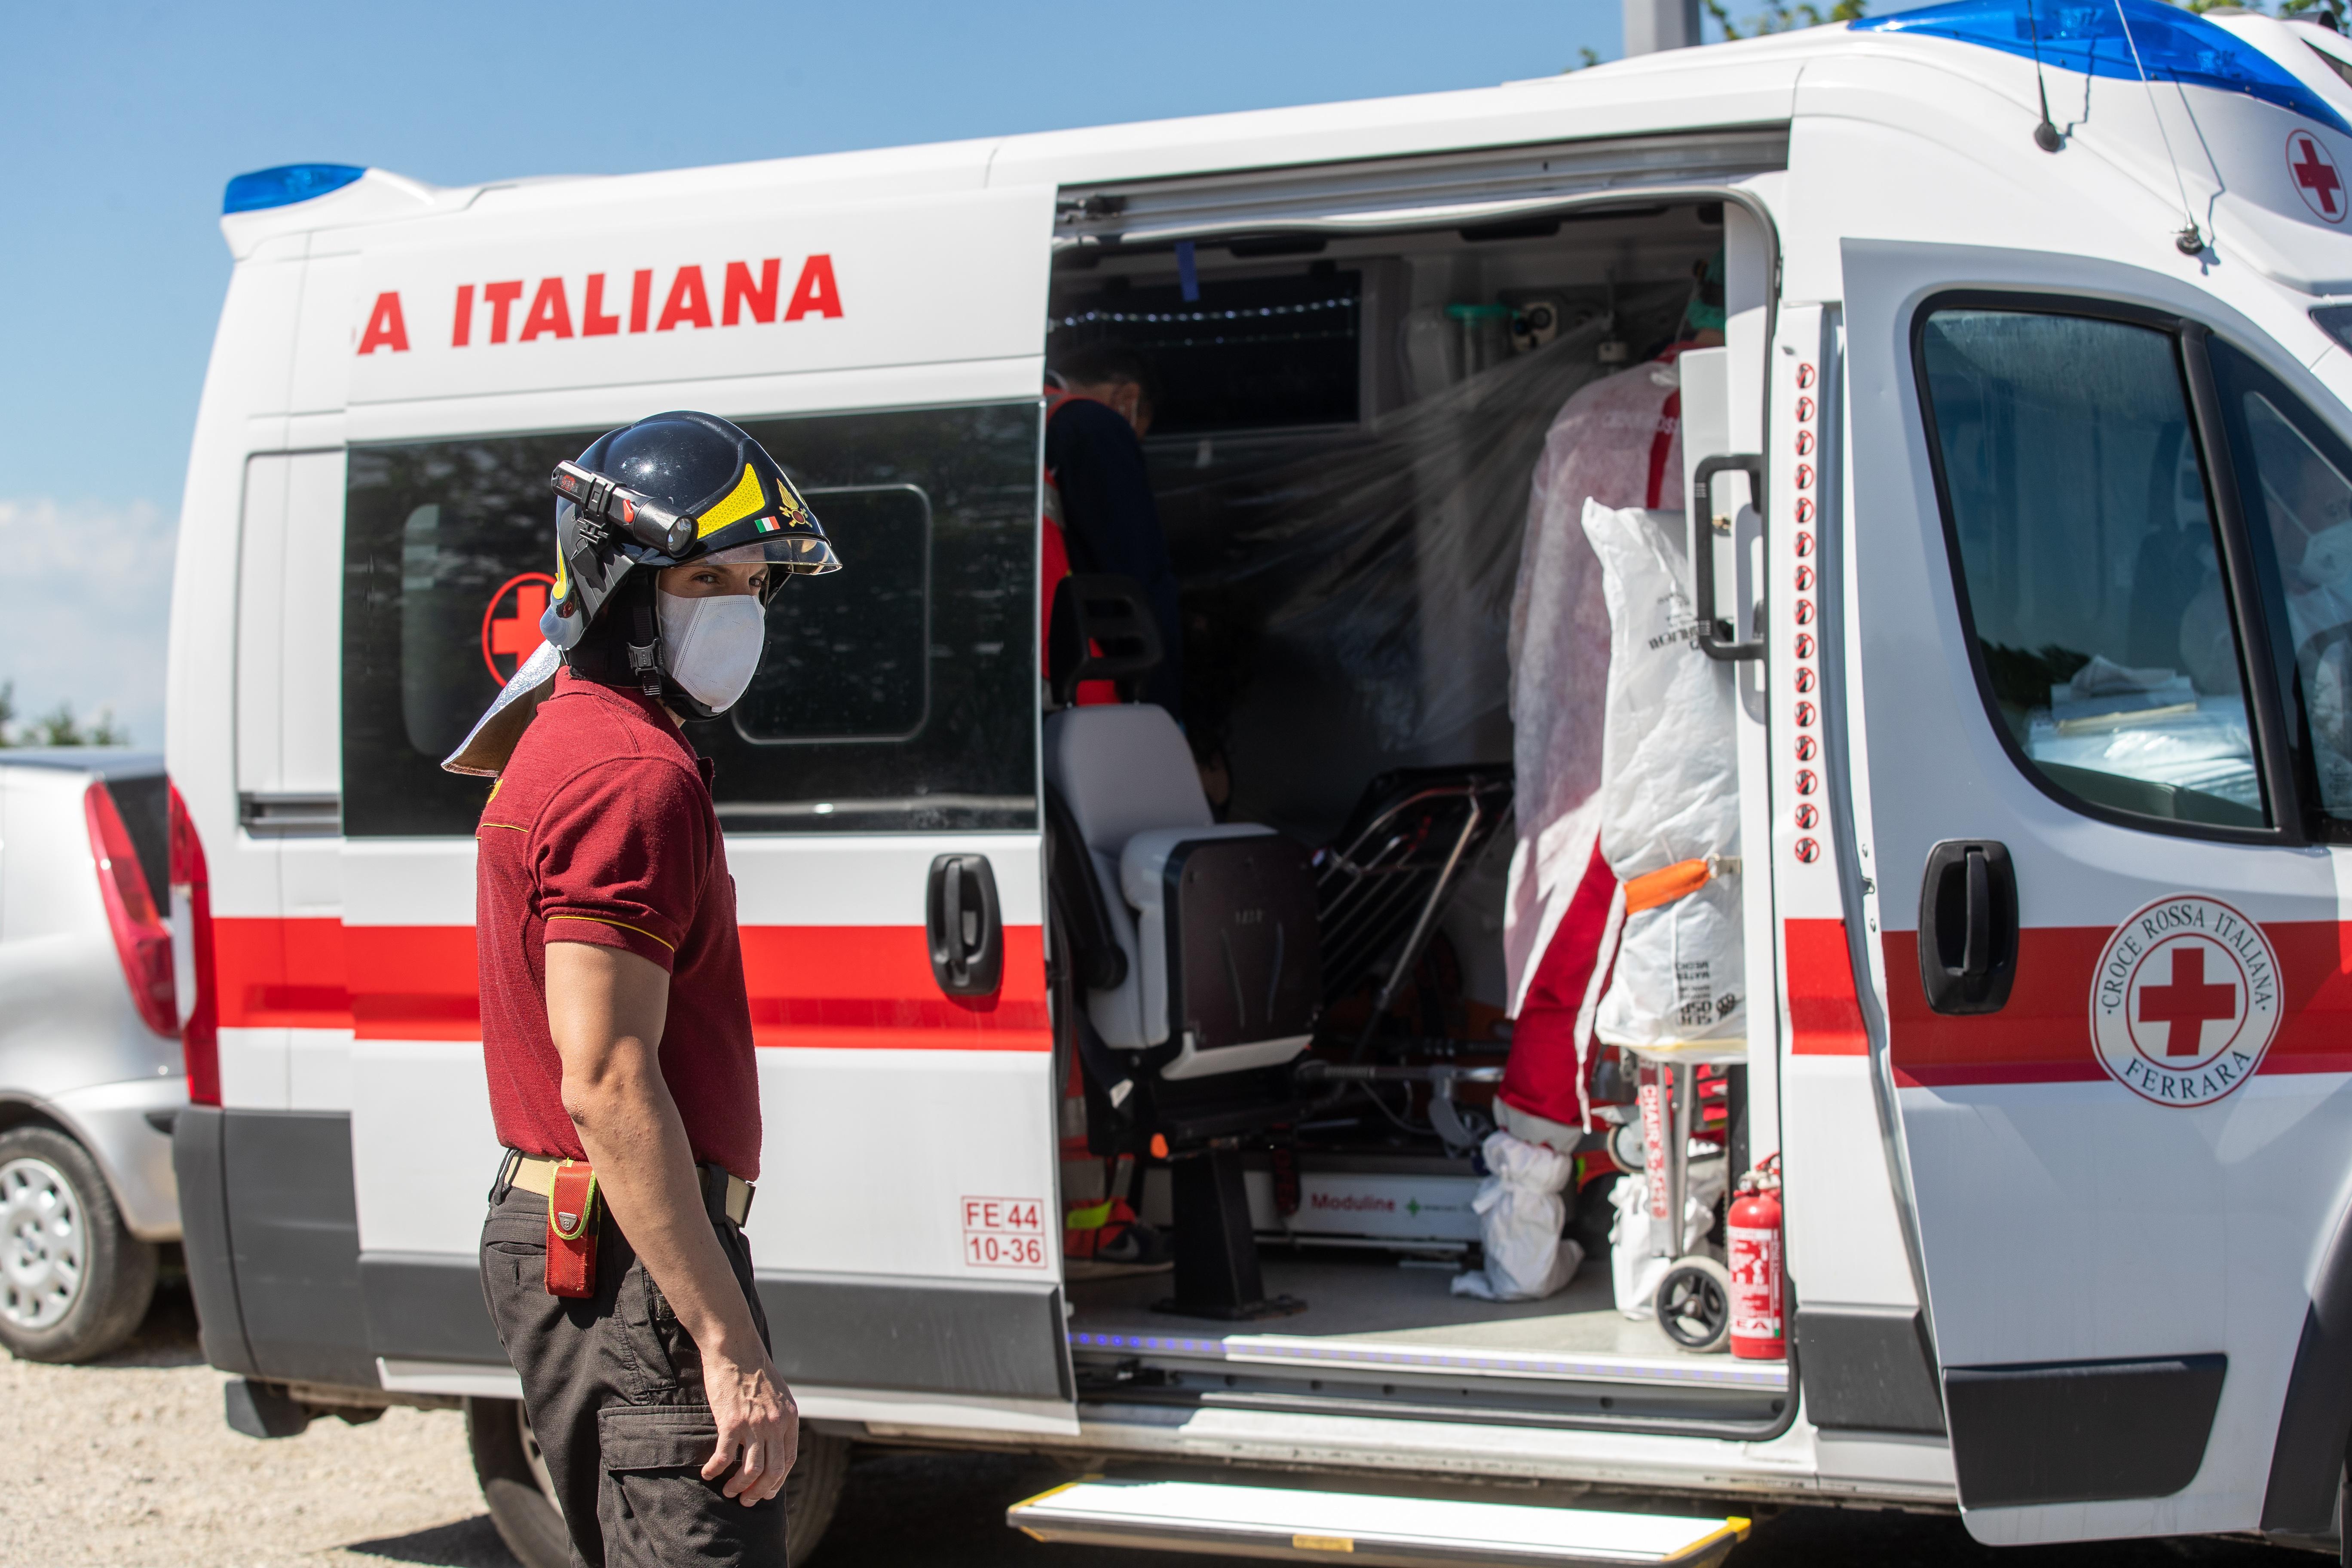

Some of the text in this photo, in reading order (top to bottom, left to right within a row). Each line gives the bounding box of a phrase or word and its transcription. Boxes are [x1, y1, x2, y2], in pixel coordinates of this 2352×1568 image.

[451, 253, 845, 348] ITALIANA
[2101, 903, 2275, 1009] CROCE ROSSA ITALIANA
[2124, 1049, 2251, 1099] FERRARA
[965, 1202, 1039, 1229] FE 44
[1311, 1192, 1396, 1213] Moduline
[969, 1237, 1041, 1264] 10-36
